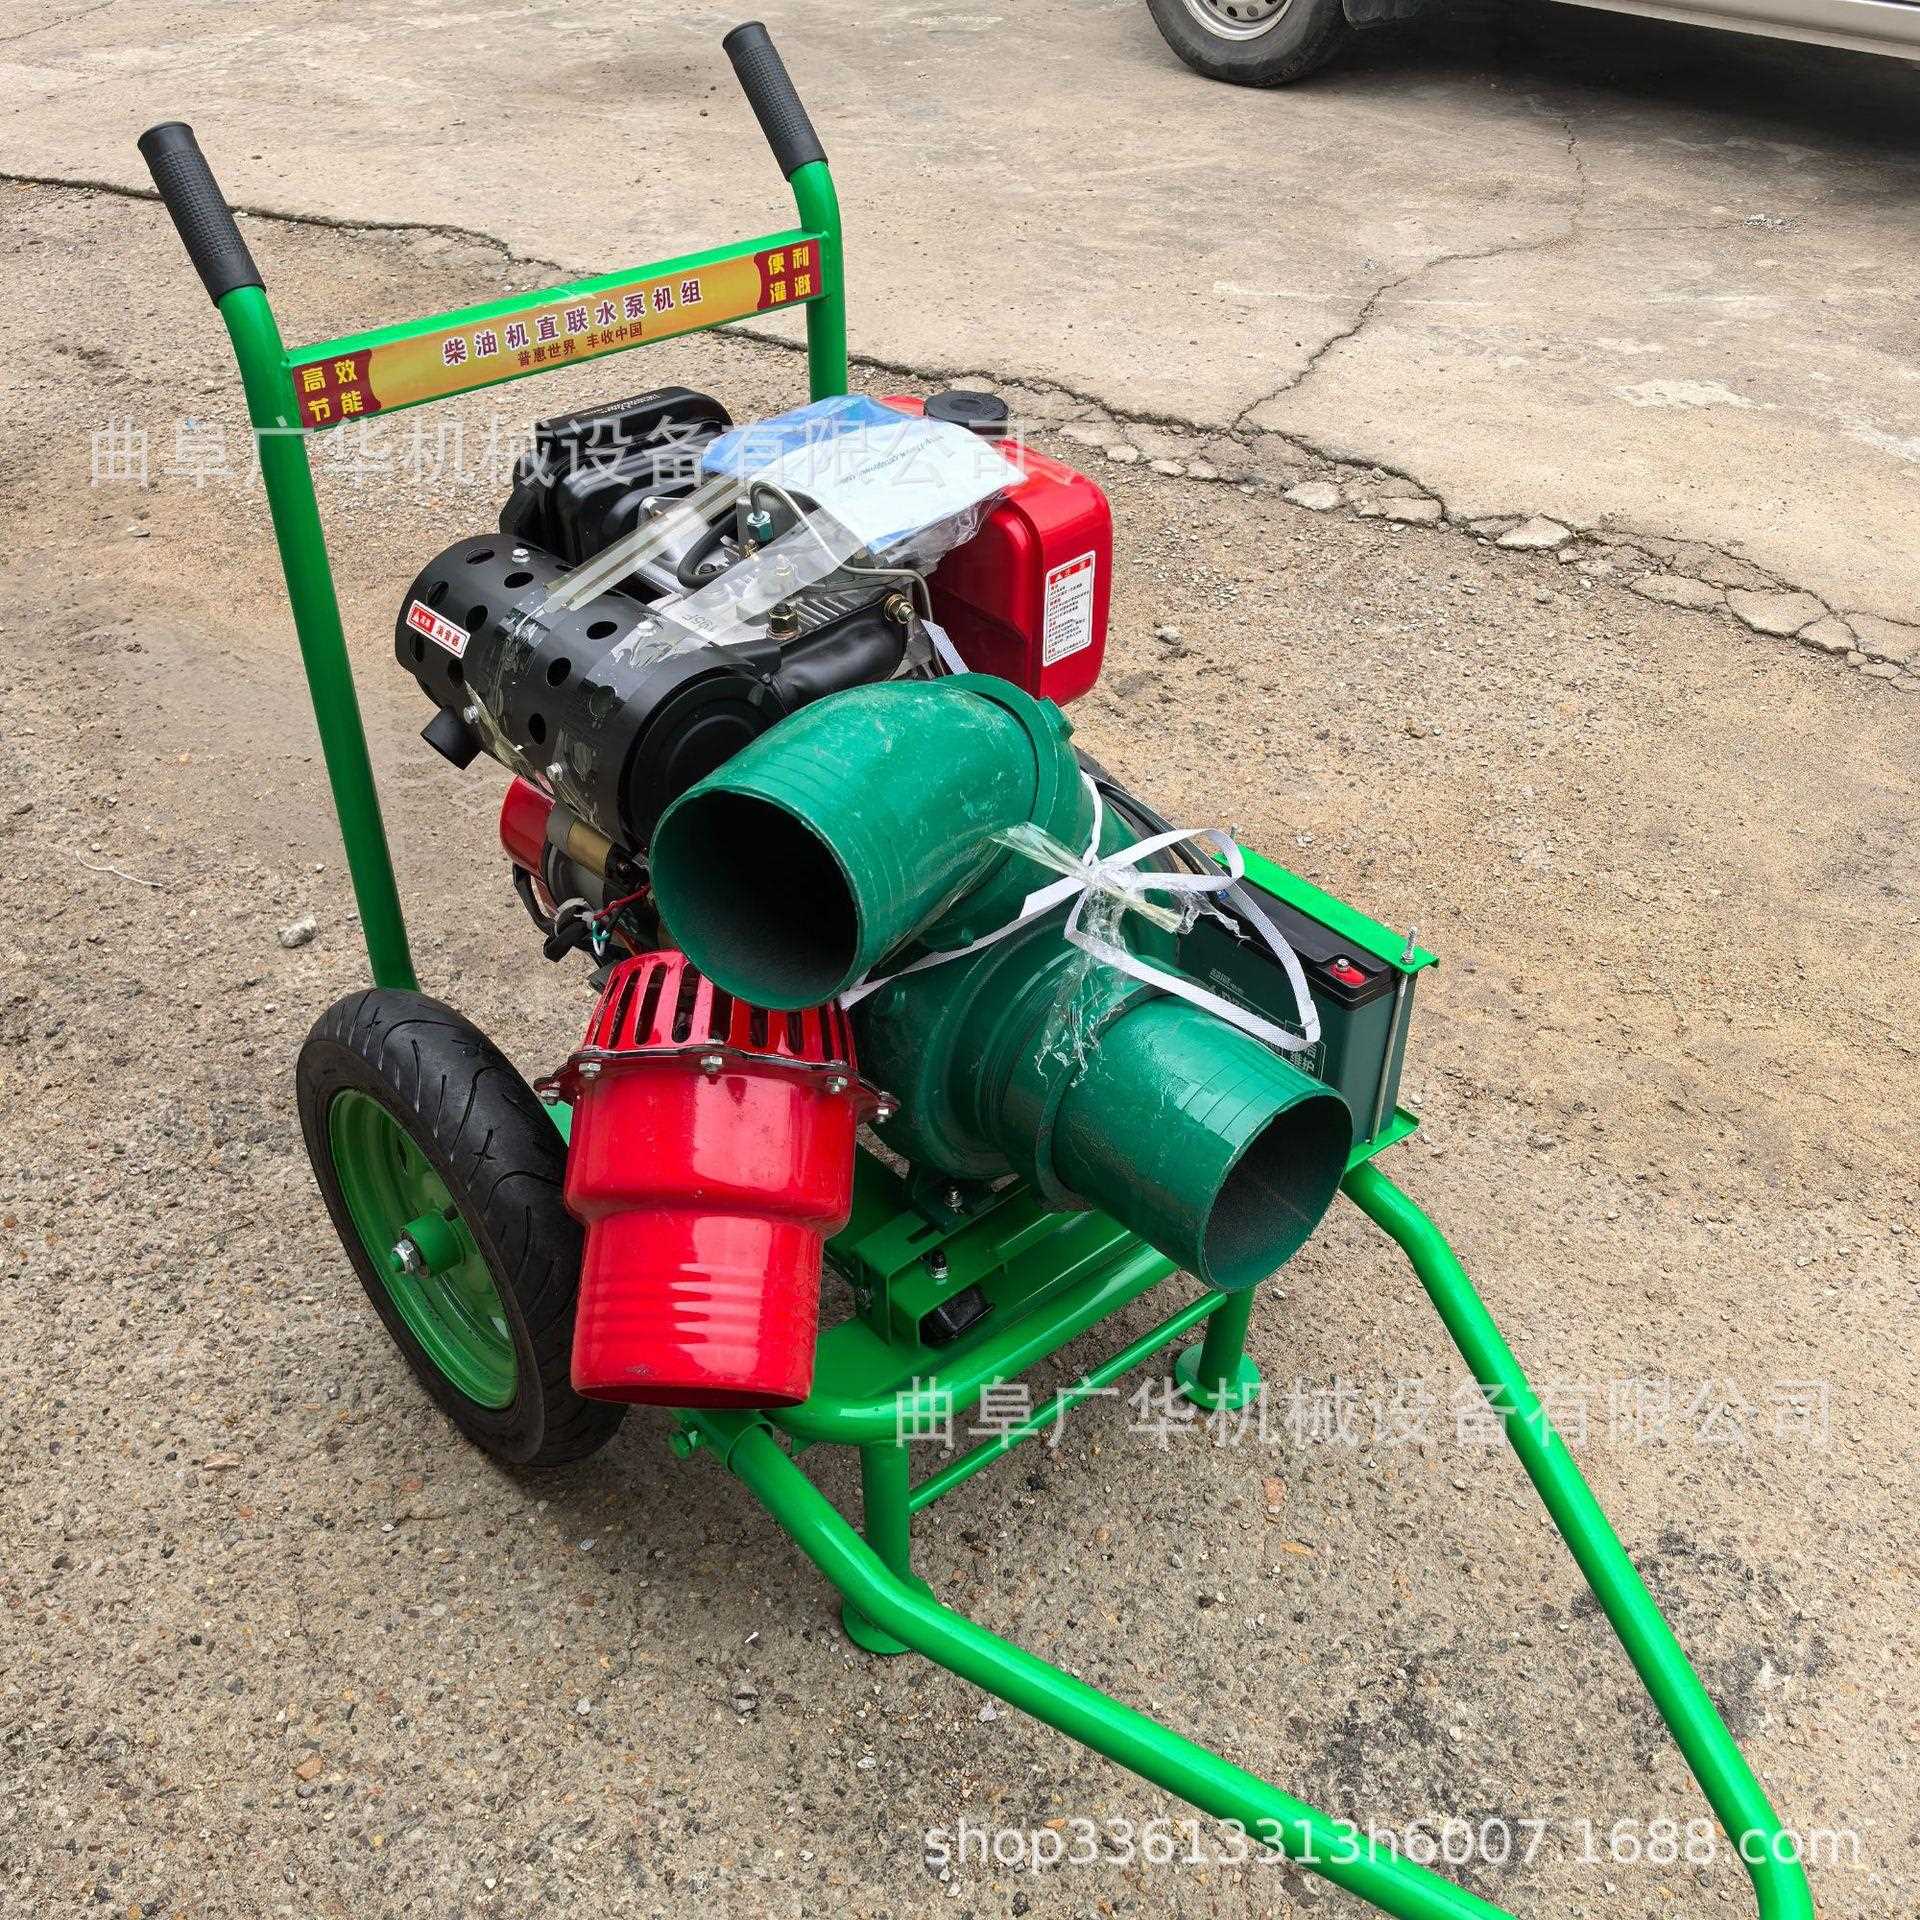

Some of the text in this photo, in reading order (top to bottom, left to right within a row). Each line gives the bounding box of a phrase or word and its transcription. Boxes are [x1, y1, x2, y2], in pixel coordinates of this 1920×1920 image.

[767, 246, 810, 276] 便利
[769, 273, 811, 304] 灌溉
[443, 279, 702, 365] 柴油机直联水泵机组
[517, 321, 643, 368] 普惠世界 丰收中国
[301, 359, 358, 392] 高效
[307, 390, 364, 422] 节能
